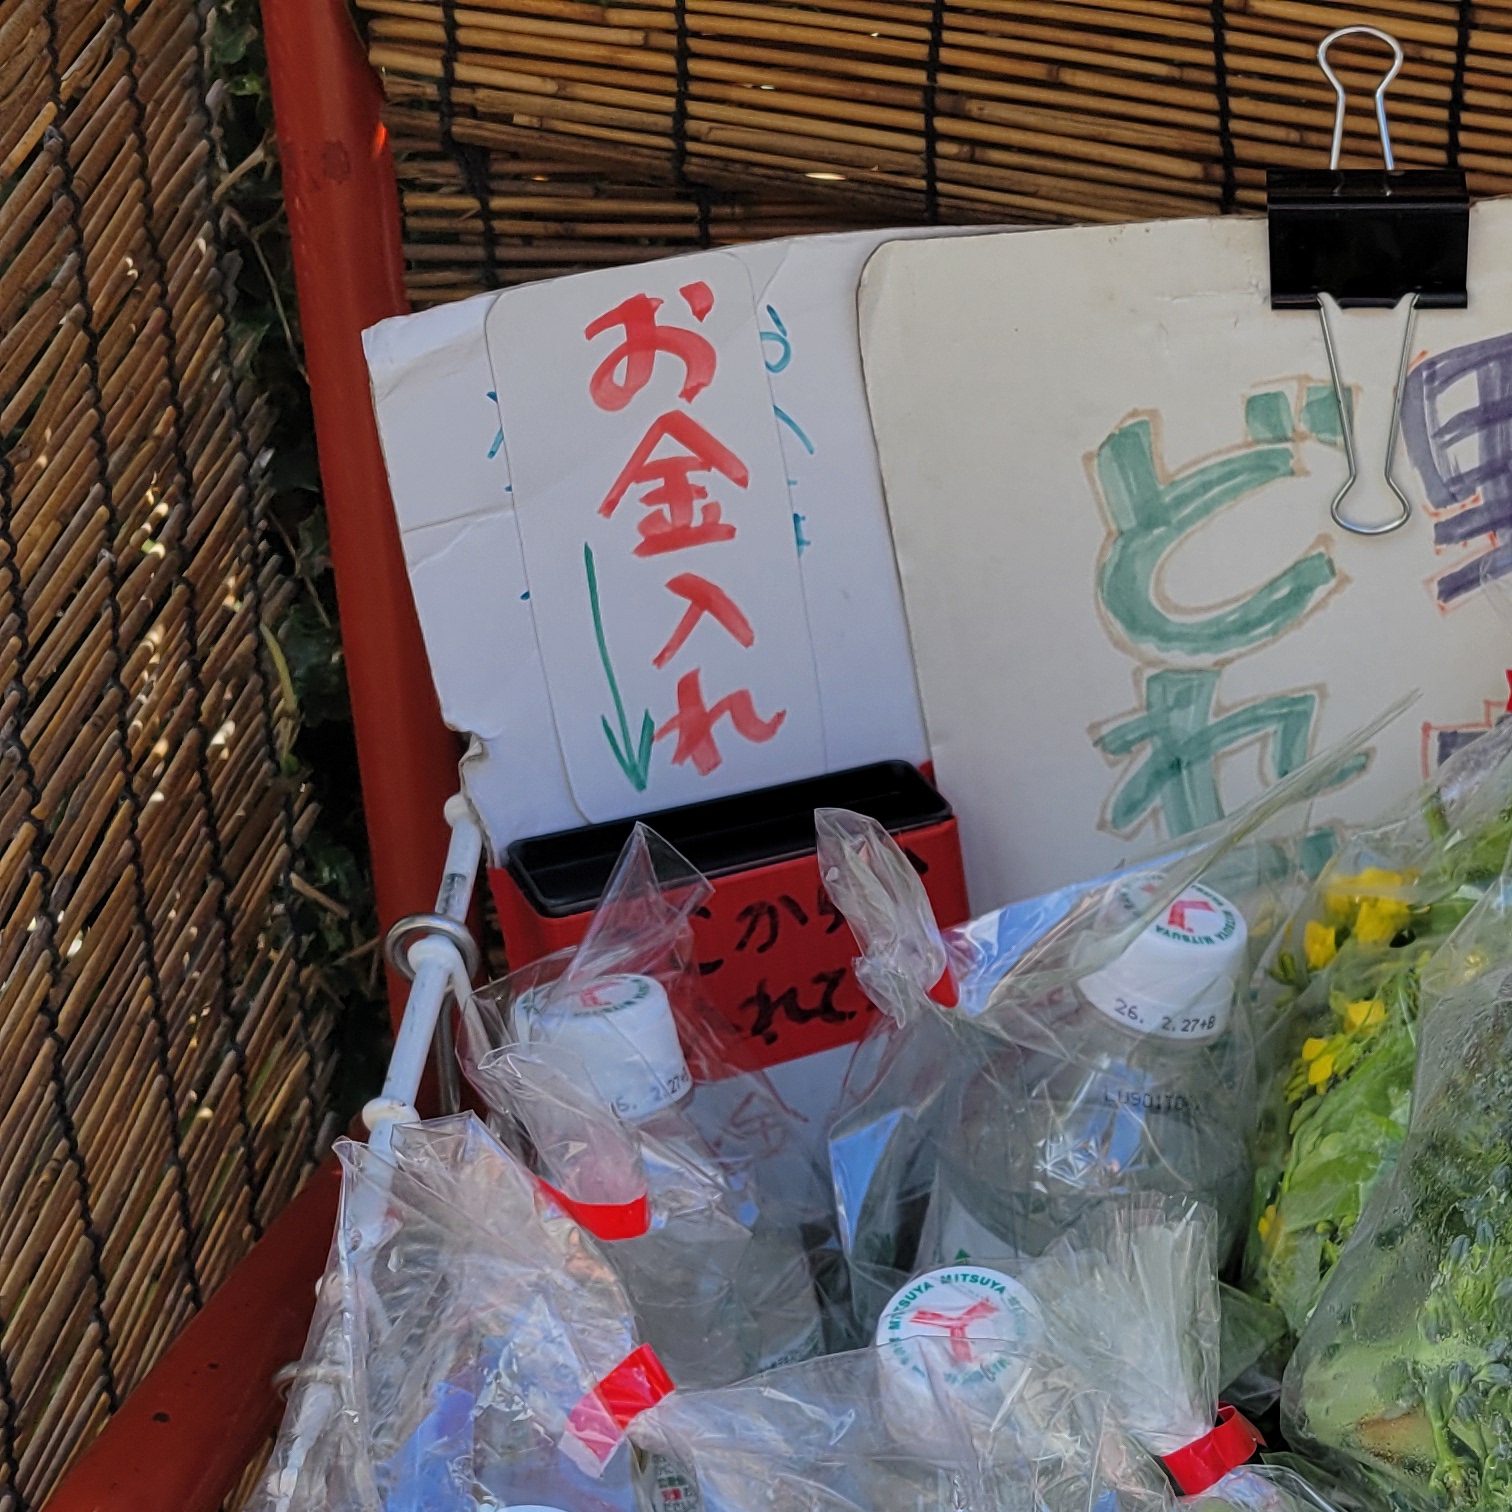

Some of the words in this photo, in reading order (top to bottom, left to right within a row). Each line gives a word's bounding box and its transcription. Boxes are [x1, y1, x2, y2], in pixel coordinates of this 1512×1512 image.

[583, 280, 787, 776] お金入れ
[1083, 375, 1372, 885] どれ
[940, 1273, 1007, 1295] MITSUYA
